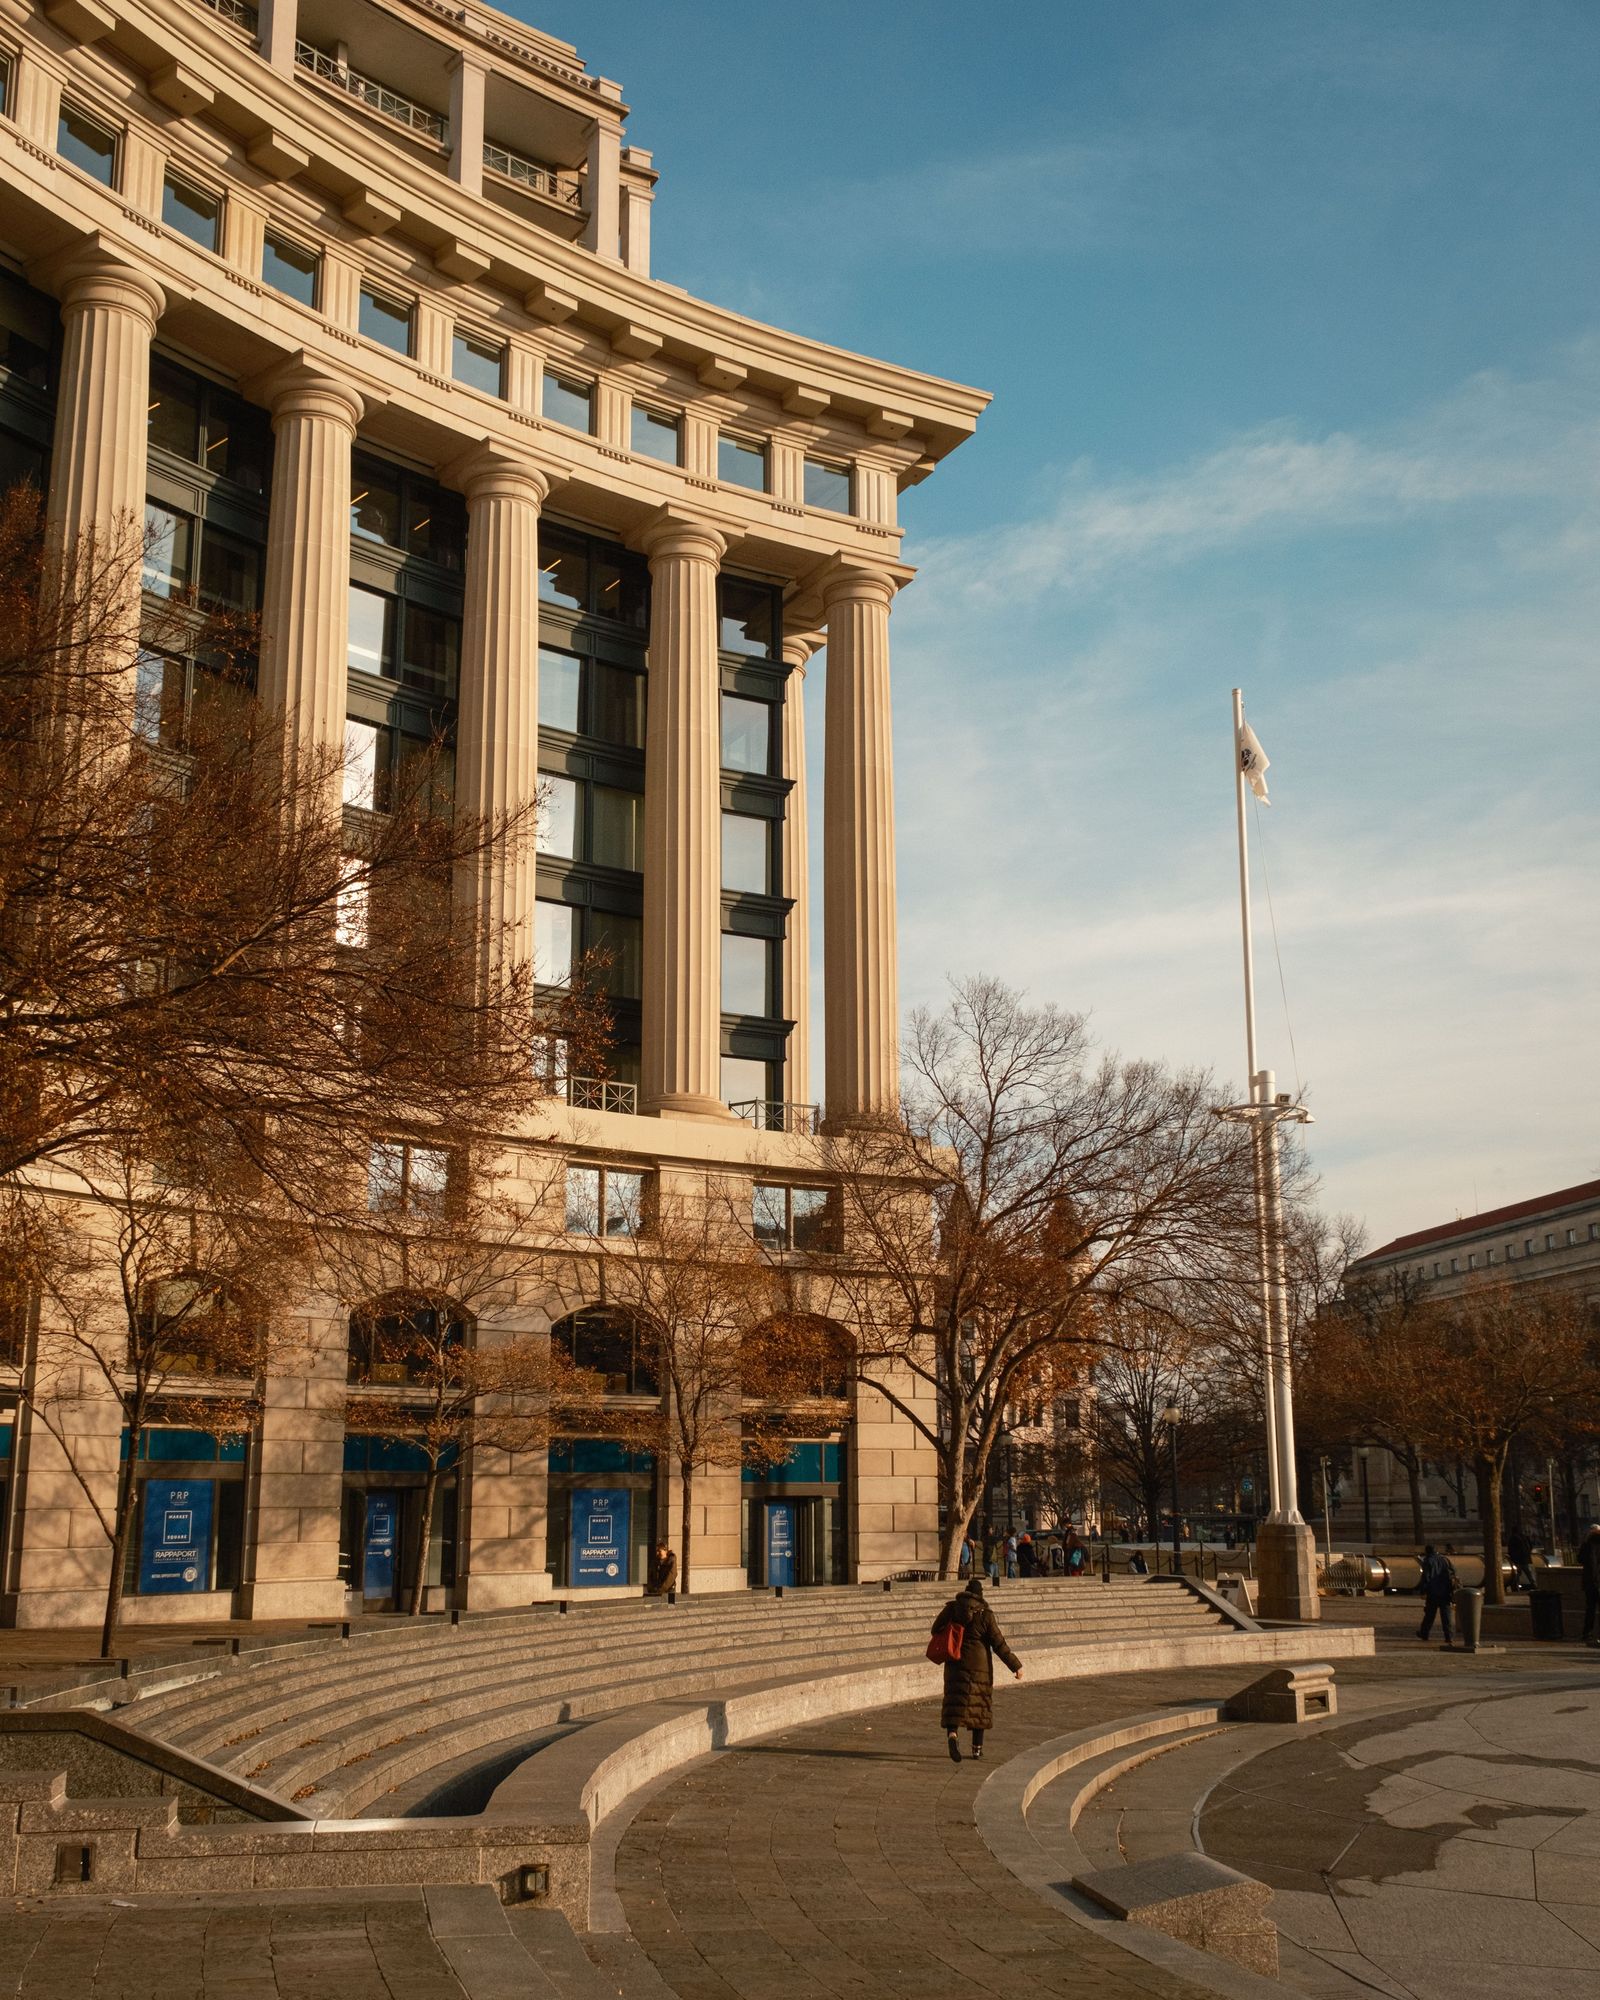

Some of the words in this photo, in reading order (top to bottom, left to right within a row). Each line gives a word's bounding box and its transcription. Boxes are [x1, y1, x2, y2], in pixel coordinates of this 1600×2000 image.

[170, 1491, 189, 1500] PRP
[592, 1499, 609, 1507] PRP
[155, 1550, 196, 1558] RAPPAPORT
